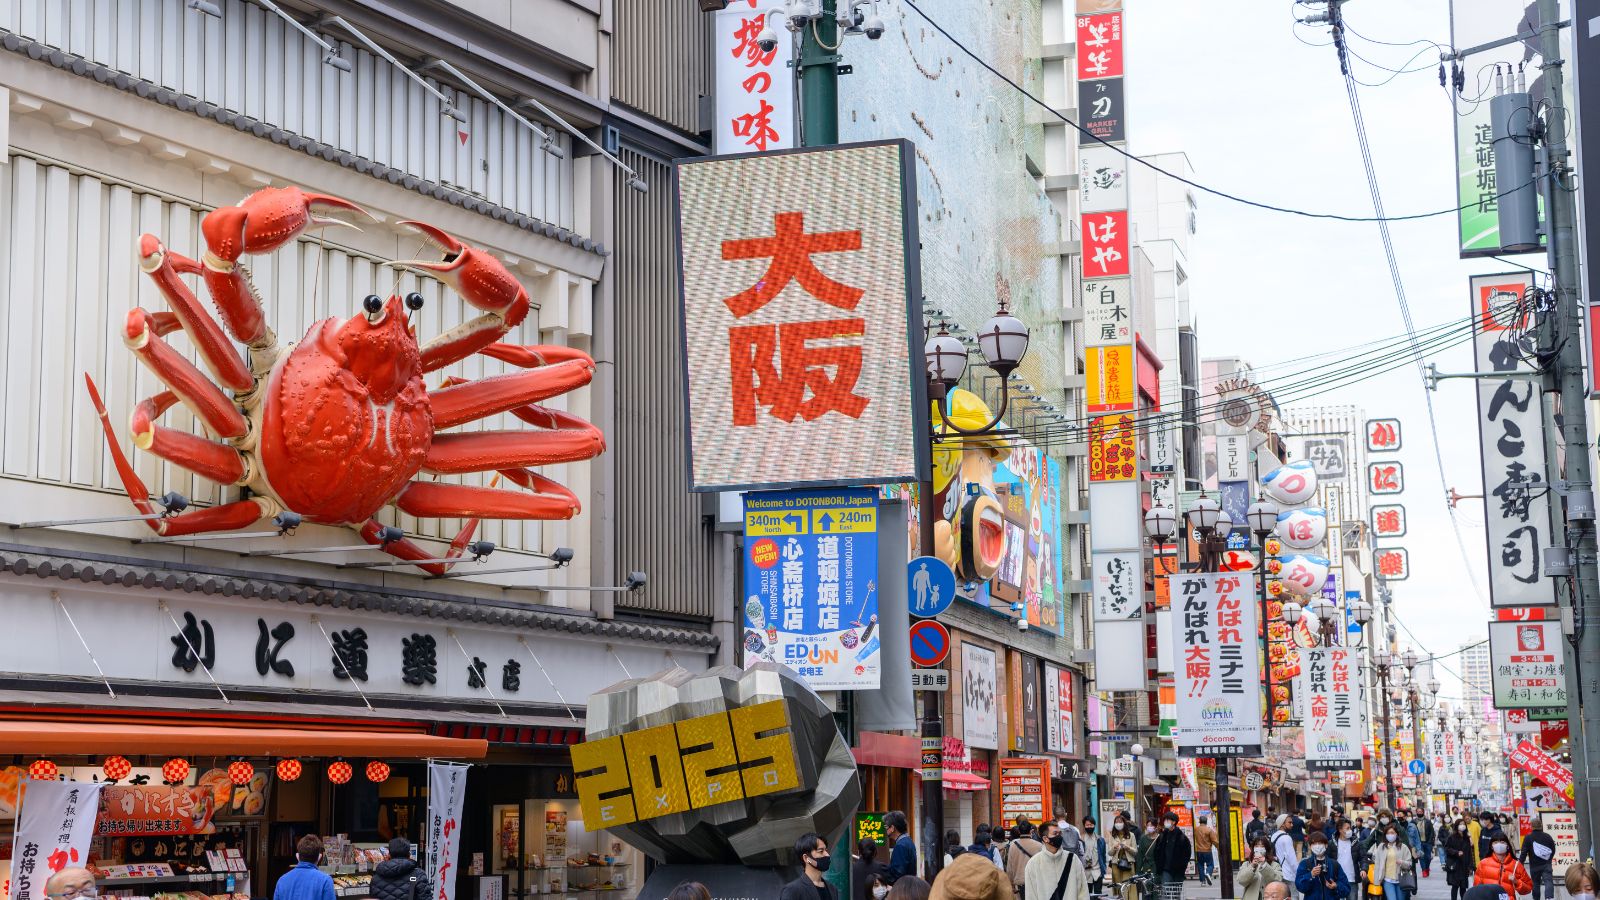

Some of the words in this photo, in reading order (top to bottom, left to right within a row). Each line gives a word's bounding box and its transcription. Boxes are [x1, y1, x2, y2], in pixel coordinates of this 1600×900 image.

[1078, 18, 1090, 28] 8F
[1096, 84, 1106, 92] 7F
[1092, 97, 1112, 117] 刀
[1087, 120, 1117, 129] MARKET
[1088, 216, 1121, 272] はや
[1086, 284, 1097, 293] 4F
[721, 211, 871, 426] 大阪
[1100, 286, 1128, 340] 白木屋
[1107, 350, 1121, 401] 鳥貴族
[746, 499, 783, 509] Welcome
[785, 499, 794, 507] to
[749, 515, 781, 527] 340m
[840, 511, 872, 524] 240m
[754, 552, 777, 564] OPEN!
[755, 543, 773, 554] NEW
[845, 536, 853, 580] DOTONBORI
[769, 570, 777, 620] SHINSAIBASHI
[845, 581, 853, 606] STORE
[1215, 577, 1244, 694] がんばれミナミ
[784, 644, 838, 665] EDION
[912, 673, 947, 686] 自動車
[1331, 650, 1351, 728] がんばれミナミ
[1507, 688, 1566, 702] 寿司・和食
[569, 698, 800, 832] 2025
[120, 787, 192, 818] かにすき
[601, 770, 779, 821] EXPO
[58, 788, 79, 844] 看板料理
[98, 820, 186, 834] お持ち帰り出来ます。
